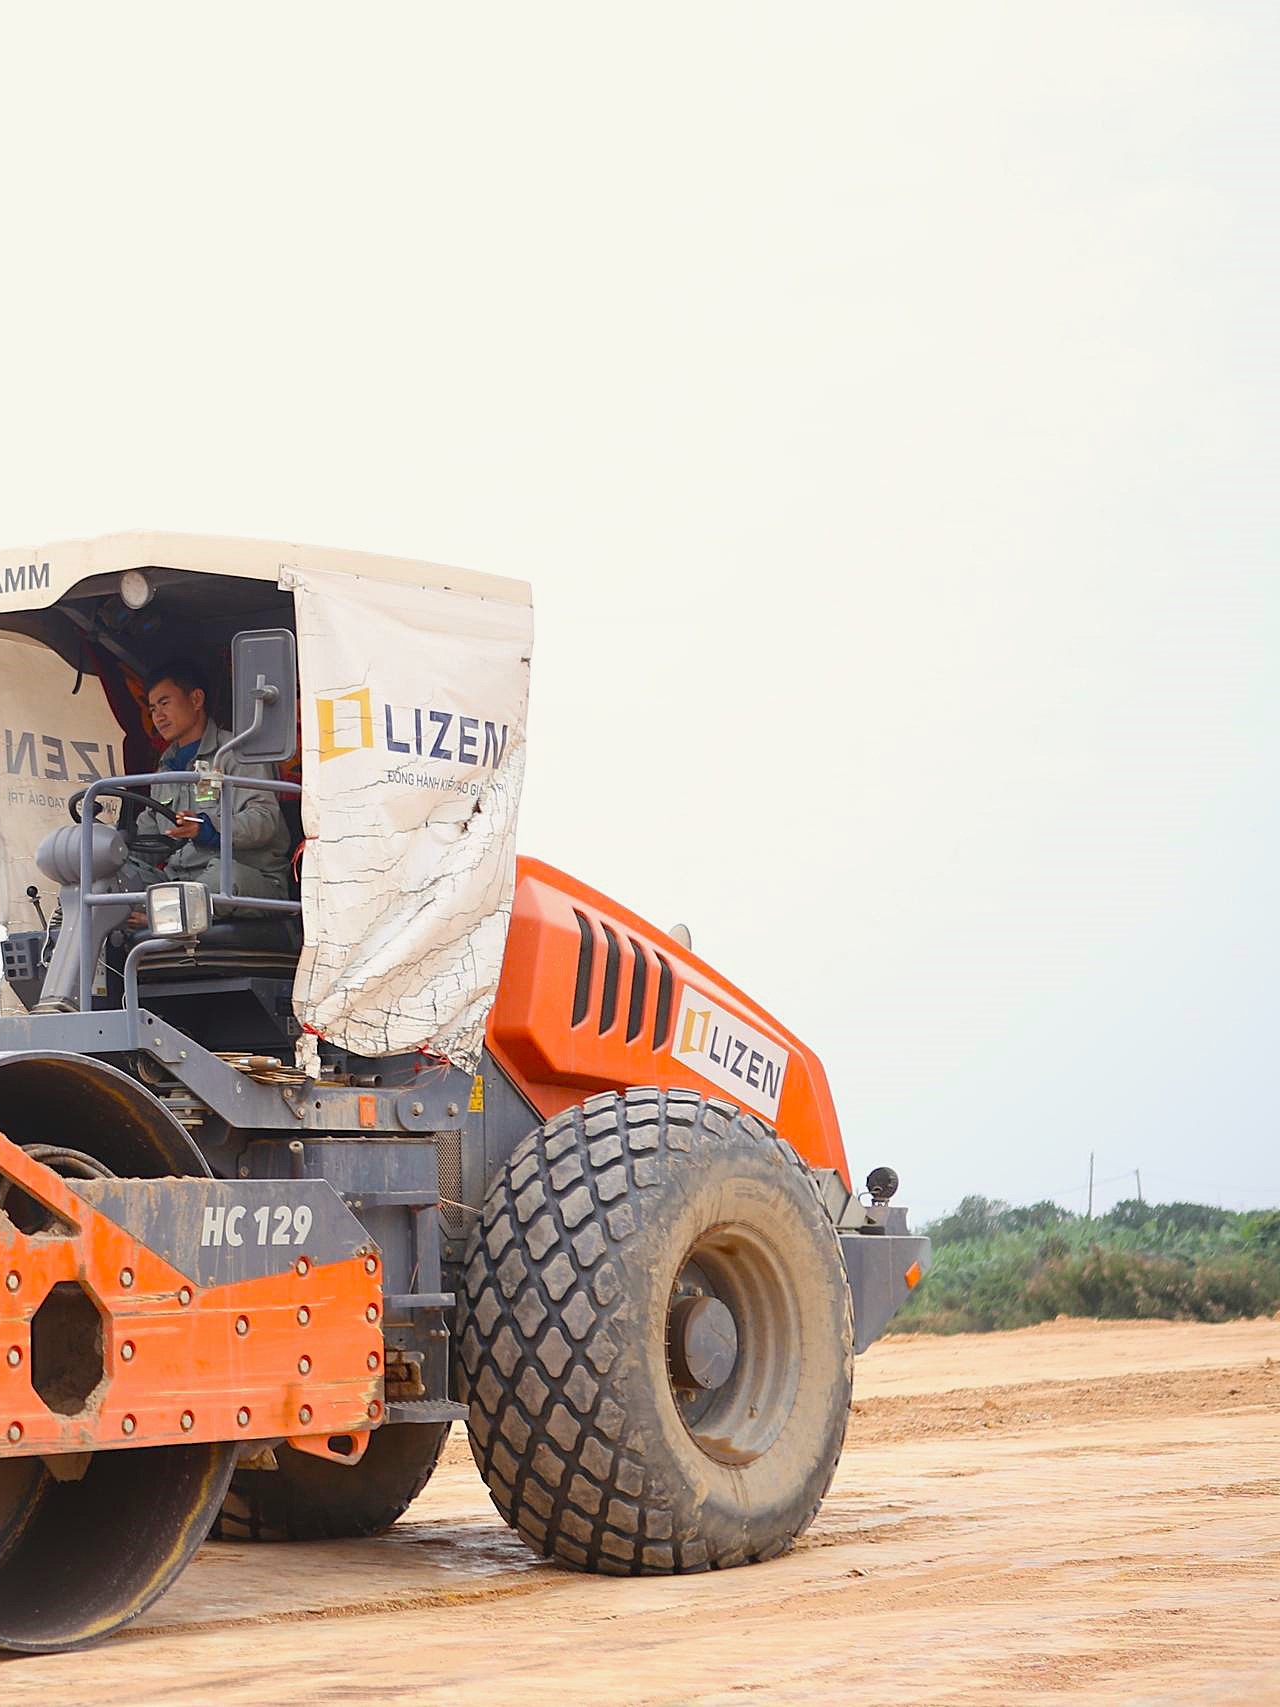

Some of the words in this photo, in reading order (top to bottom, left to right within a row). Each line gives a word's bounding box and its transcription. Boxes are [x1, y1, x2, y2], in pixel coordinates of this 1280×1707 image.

[384, 703, 509, 770] LIZEN
[708, 1025, 782, 1100] LIZEN
[200, 1205, 247, 1247] HC
[253, 1205, 313, 1246] 129
